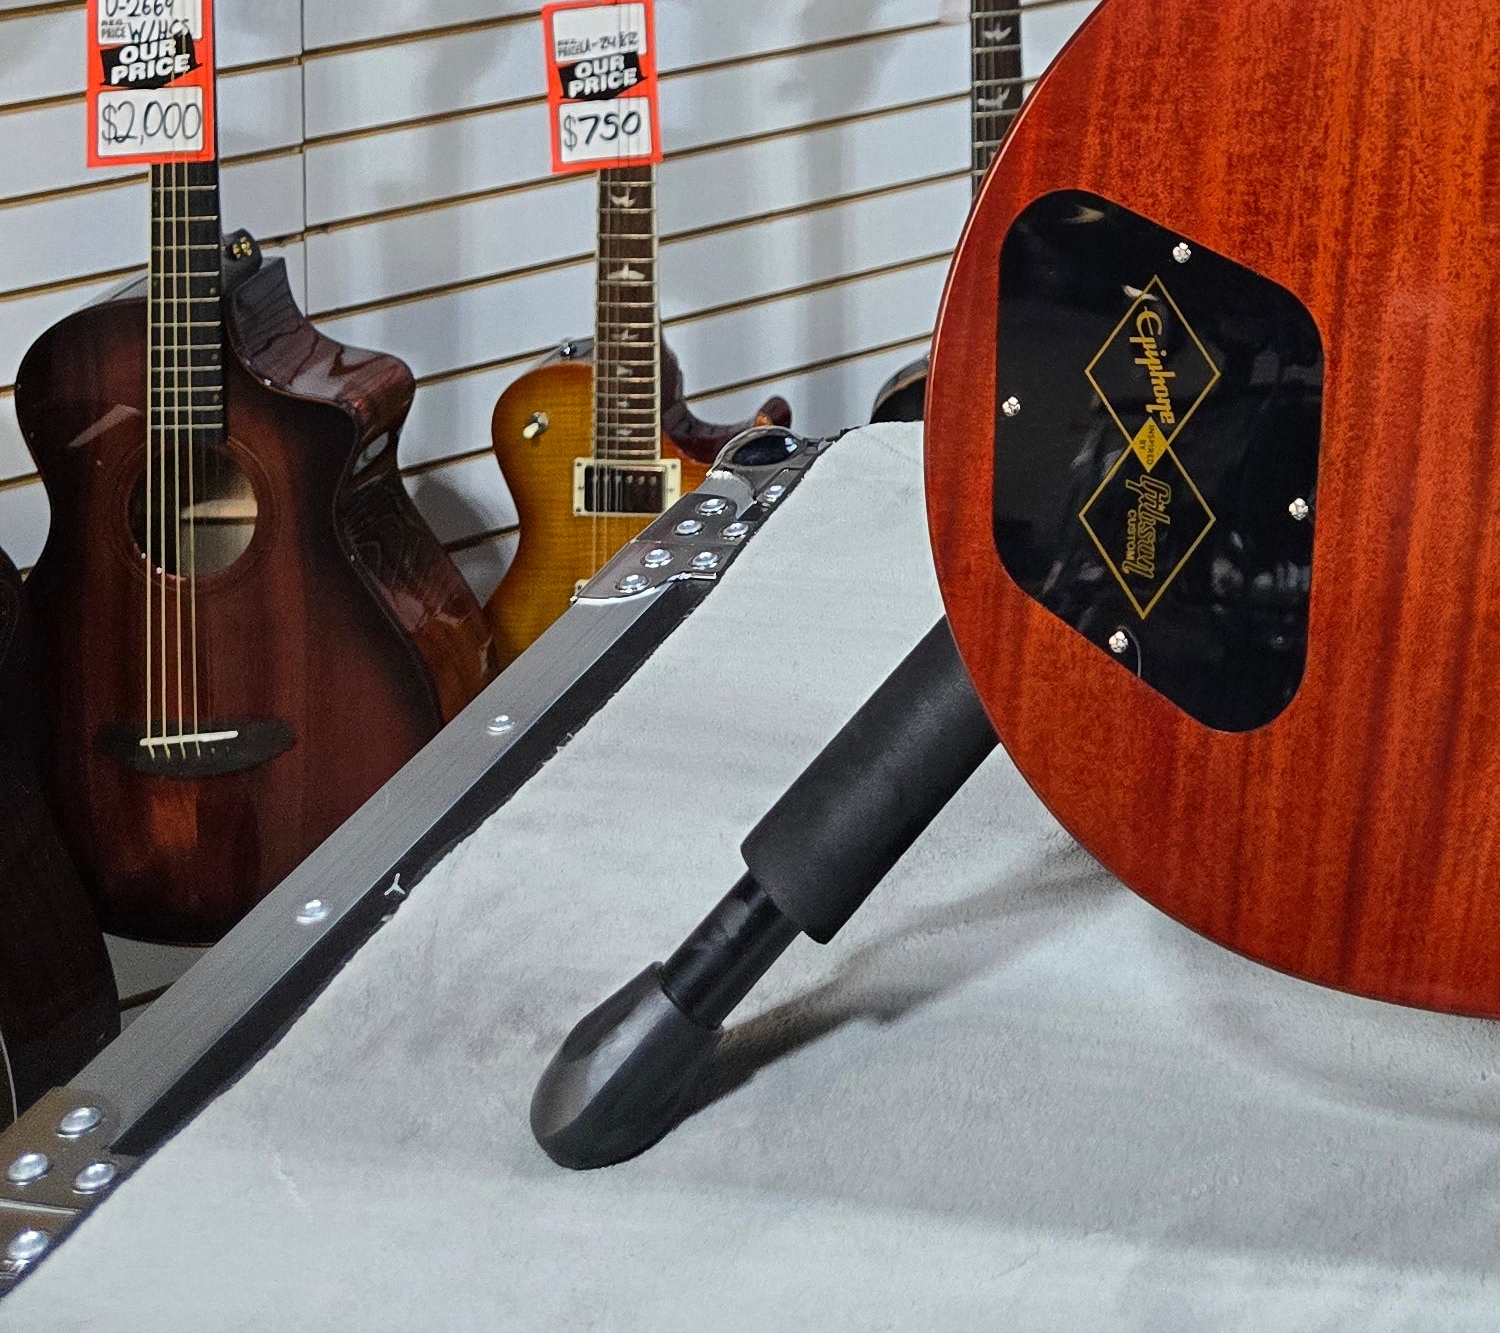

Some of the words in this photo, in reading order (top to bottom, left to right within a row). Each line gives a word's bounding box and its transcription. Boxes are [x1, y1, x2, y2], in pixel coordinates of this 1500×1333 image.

[111, 53, 191, 85] PRICE
[119, 39, 177, 64] OUR
[574, 55, 625, 79] OUR
[568, 67, 638, 98] PRICE
[102, 101, 201, 146] $2,000
[563, 111, 641, 151] $750
[1129, 306, 1177, 425] Epiphone
[1147, 424, 1156, 466] INSPIRED
[1122, 474, 1171, 579] Gibson
[1126, 508, 1138, 561] CUSTOM
